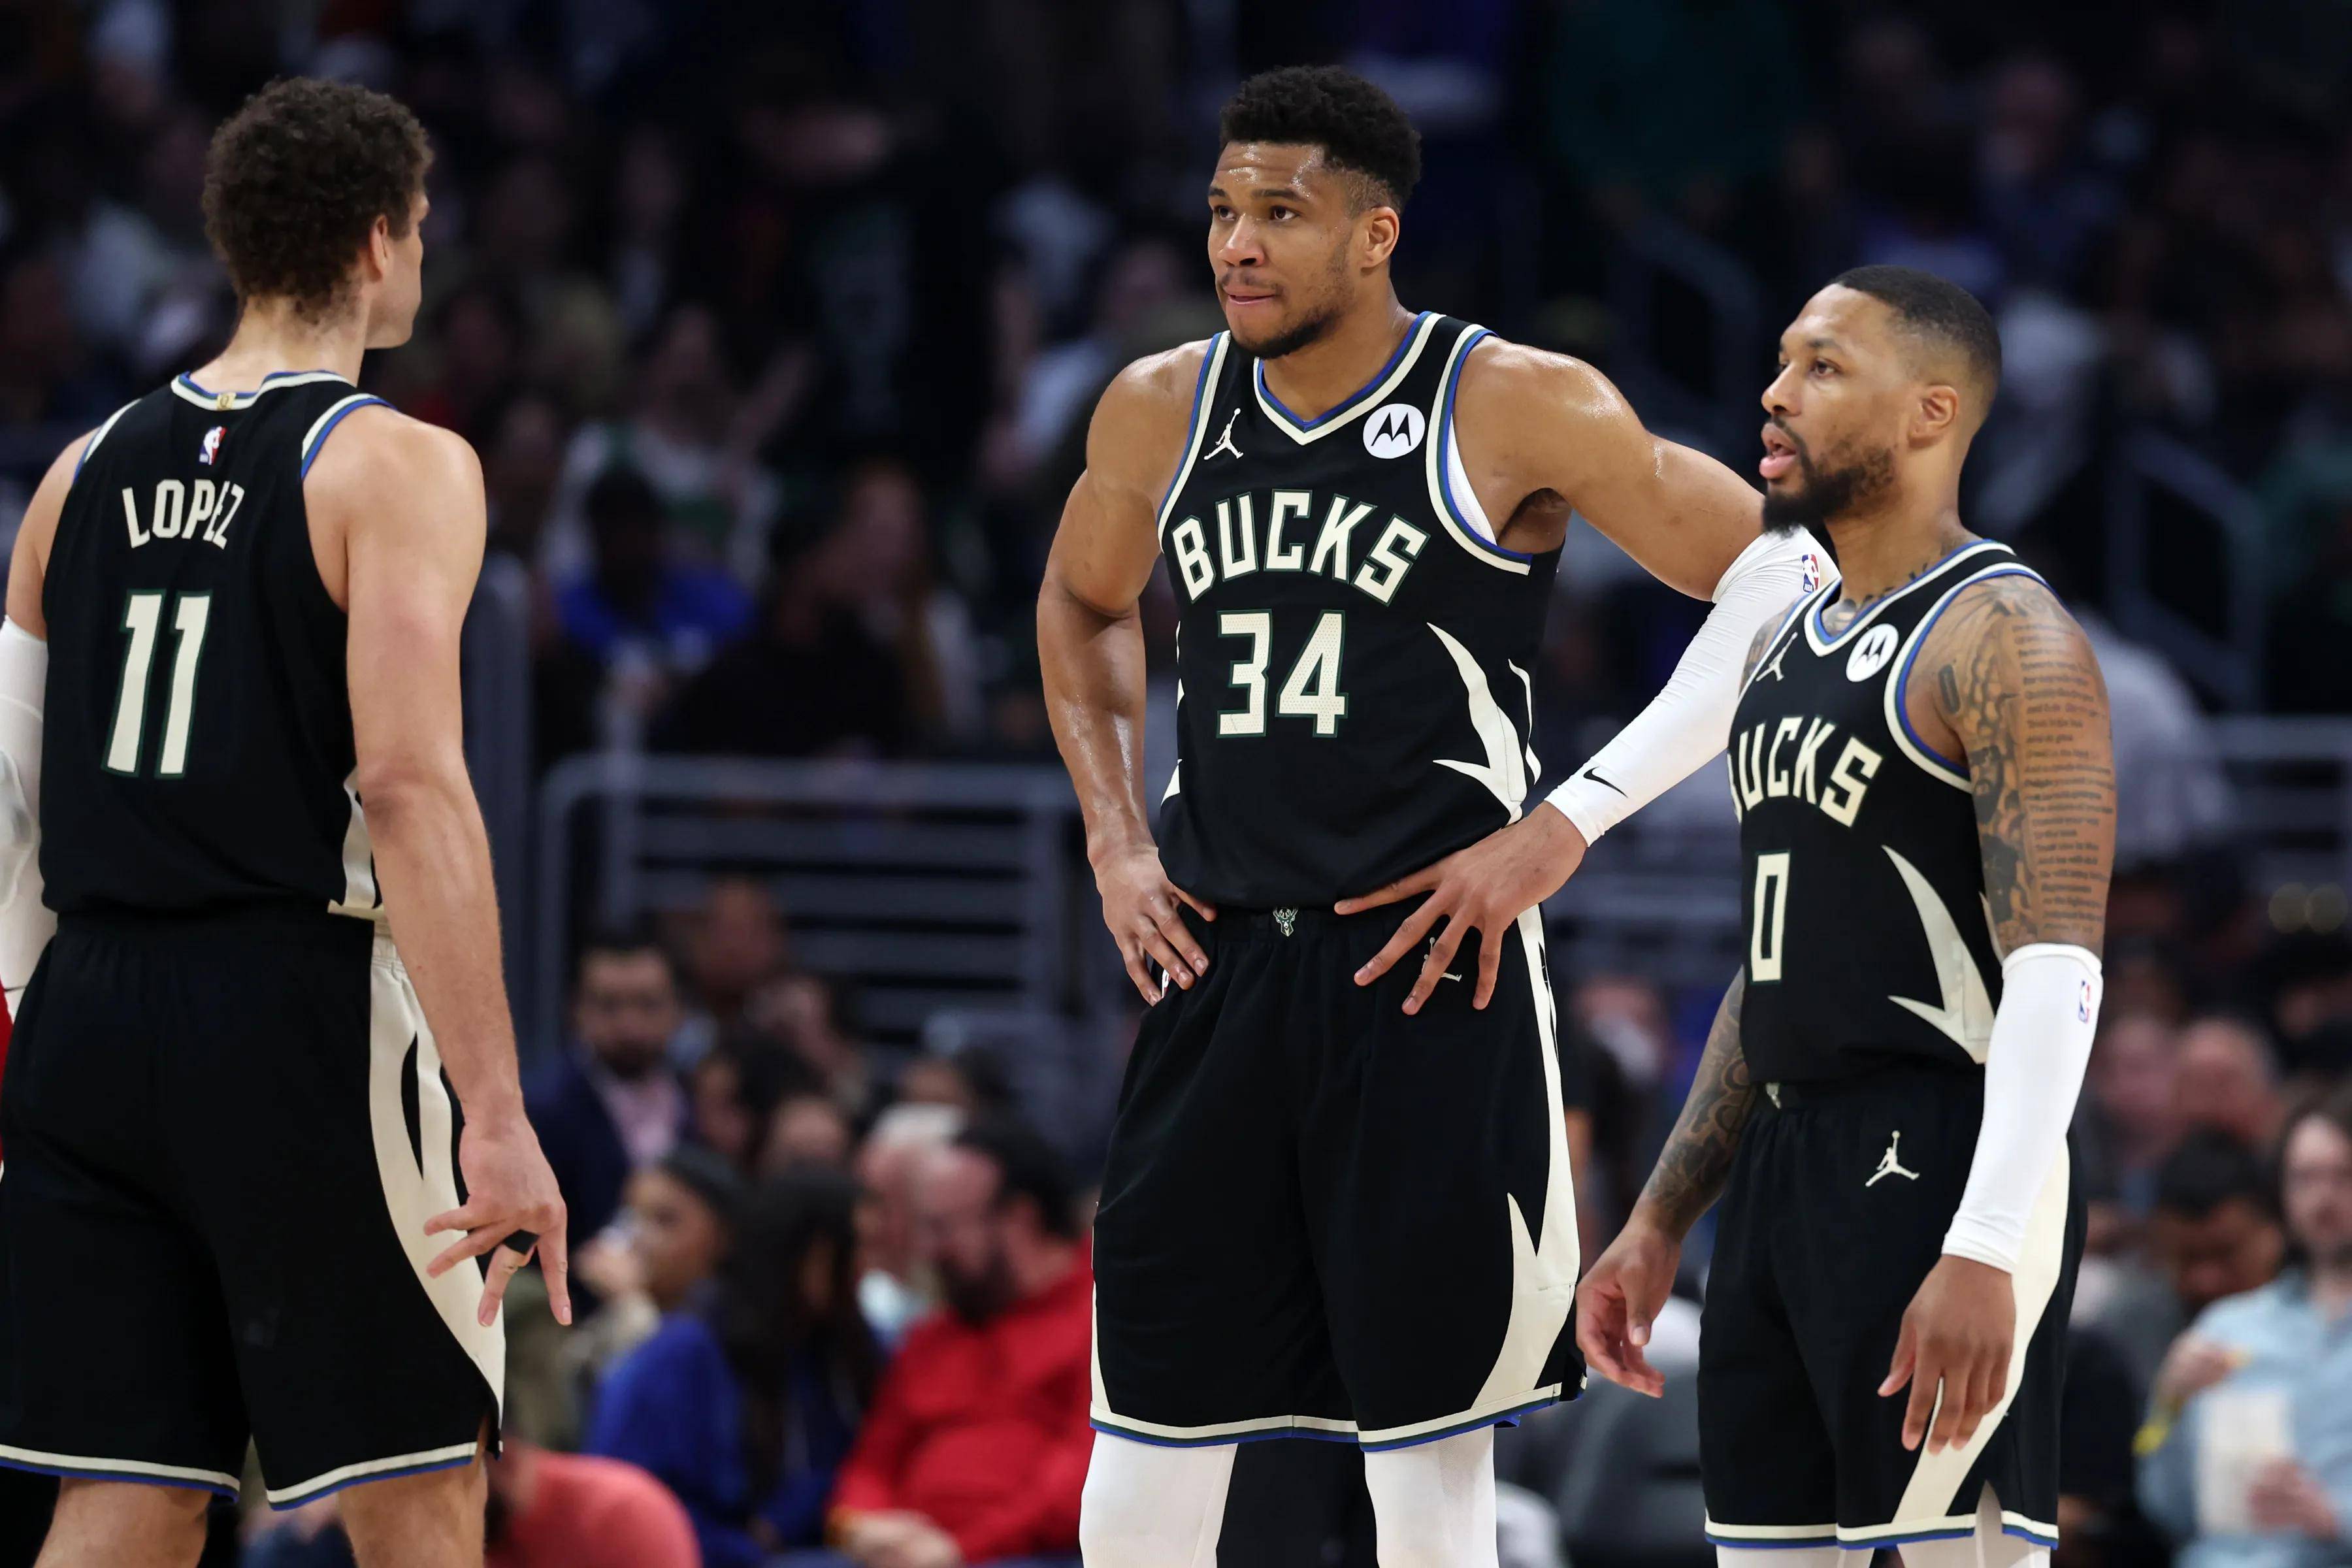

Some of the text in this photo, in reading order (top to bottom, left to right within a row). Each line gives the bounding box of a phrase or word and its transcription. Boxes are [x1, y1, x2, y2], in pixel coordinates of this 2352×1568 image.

[122, 478, 245, 550] LOPEZ
[1169, 489, 1431, 607] BUCKS
[101, 588, 214, 778] 11
[1217, 608, 1348, 738] 34
[1727, 715, 1883, 828] UCKS
[1750, 849, 1791, 984] 0
